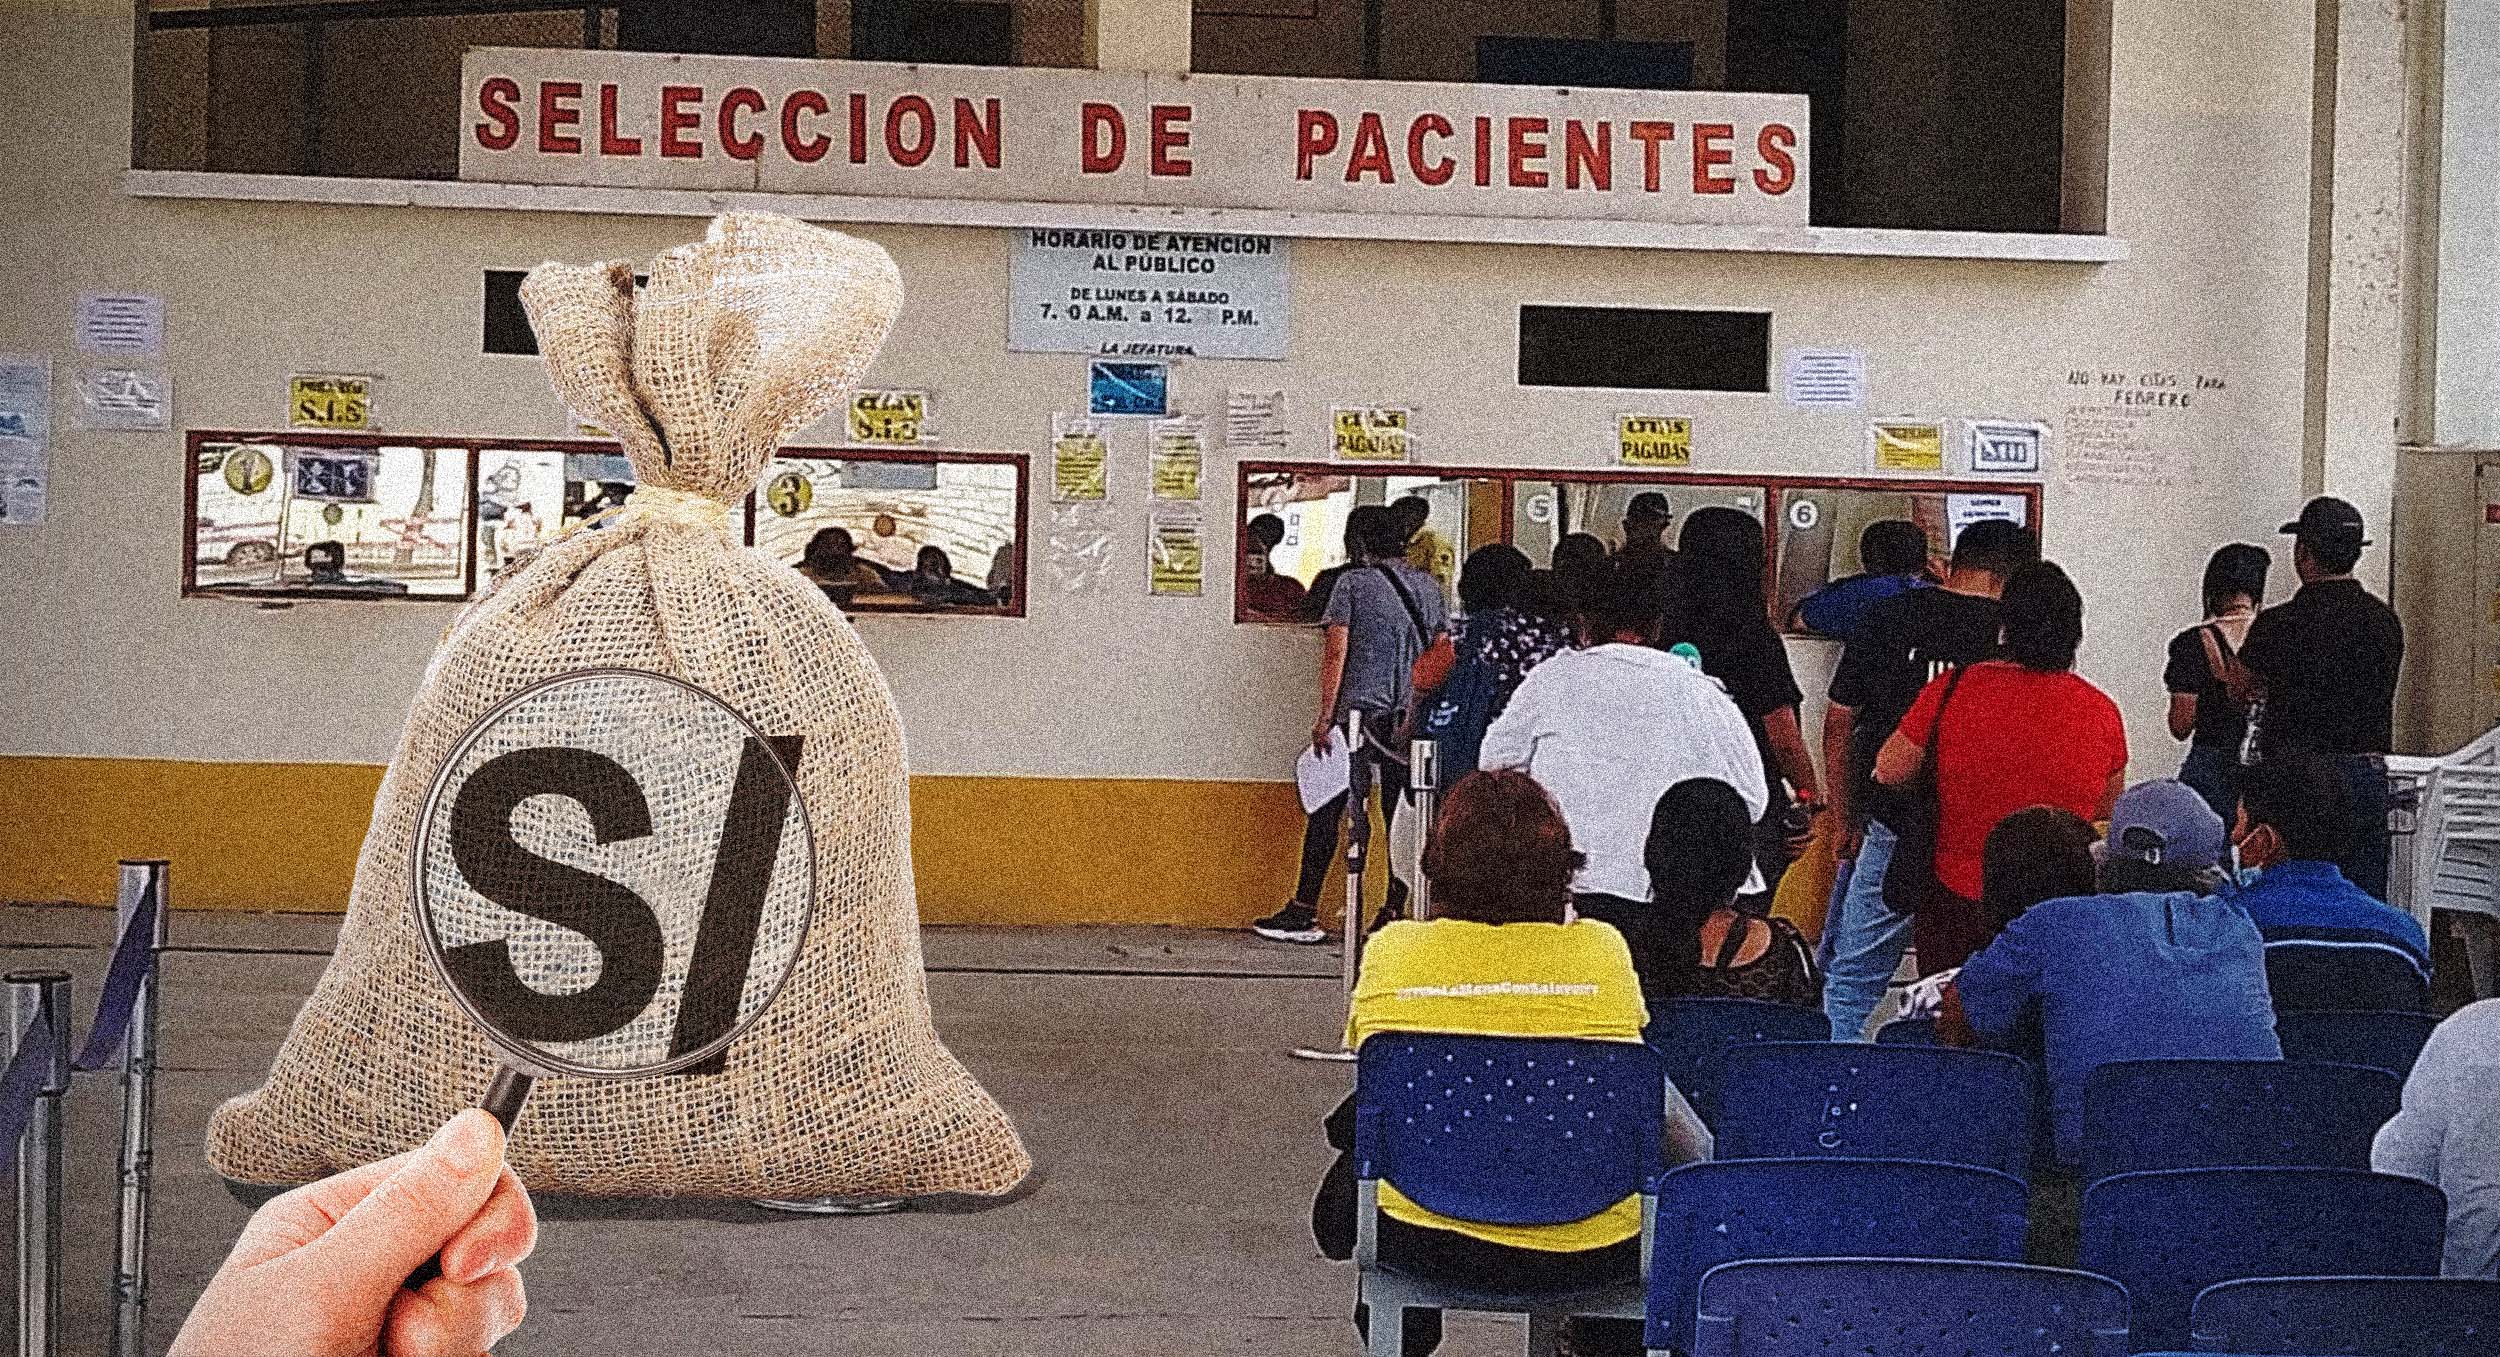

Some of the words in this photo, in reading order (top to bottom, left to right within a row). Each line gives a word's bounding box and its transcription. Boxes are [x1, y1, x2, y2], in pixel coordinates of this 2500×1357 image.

[475, 78, 1001, 169] SELECCION
[1081, 101, 1192, 176] DE
[1296, 108, 1796, 196] PACIENTES
[1031, 230, 1126, 251] HORARIO
[1132, 233, 1160, 251] DE
[1093, 254, 1119, 272] AL
[1070, 287, 1096, 301] DE
[1095, 288, 1147, 303] LUNES
[1150, 289, 1164, 304] A
[1086, 304, 1129, 322] A.M.
[1140, 309, 1152, 323] a
[1221, 308, 1259, 327] P.M.
[1100, 342, 1120, 355] LA
[2067, 370, 2090, 386] NO
